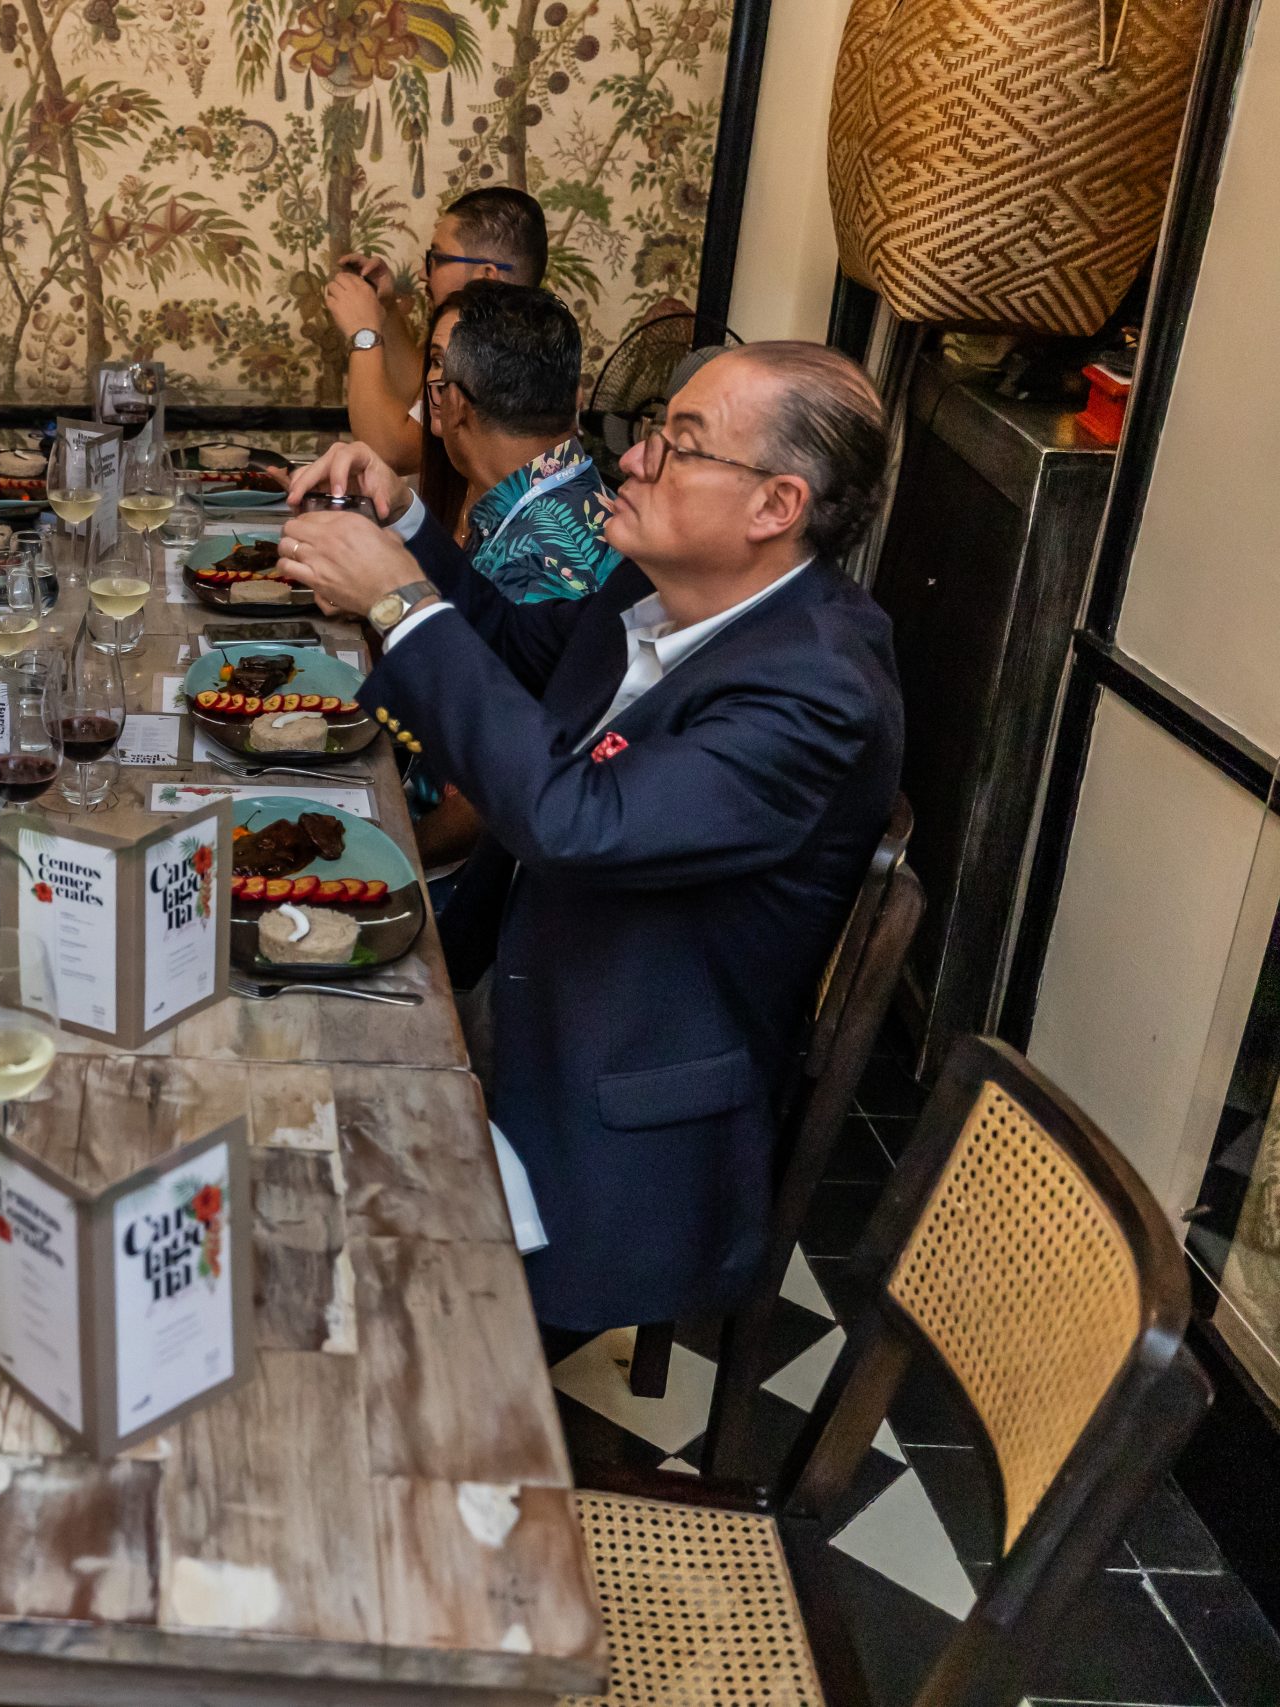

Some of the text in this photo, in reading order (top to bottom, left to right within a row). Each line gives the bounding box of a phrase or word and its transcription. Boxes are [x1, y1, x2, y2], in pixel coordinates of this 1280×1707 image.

[38, 852, 102, 880] Centros
[38, 867, 93, 892] Comer
[55, 885, 104, 907] ciales
